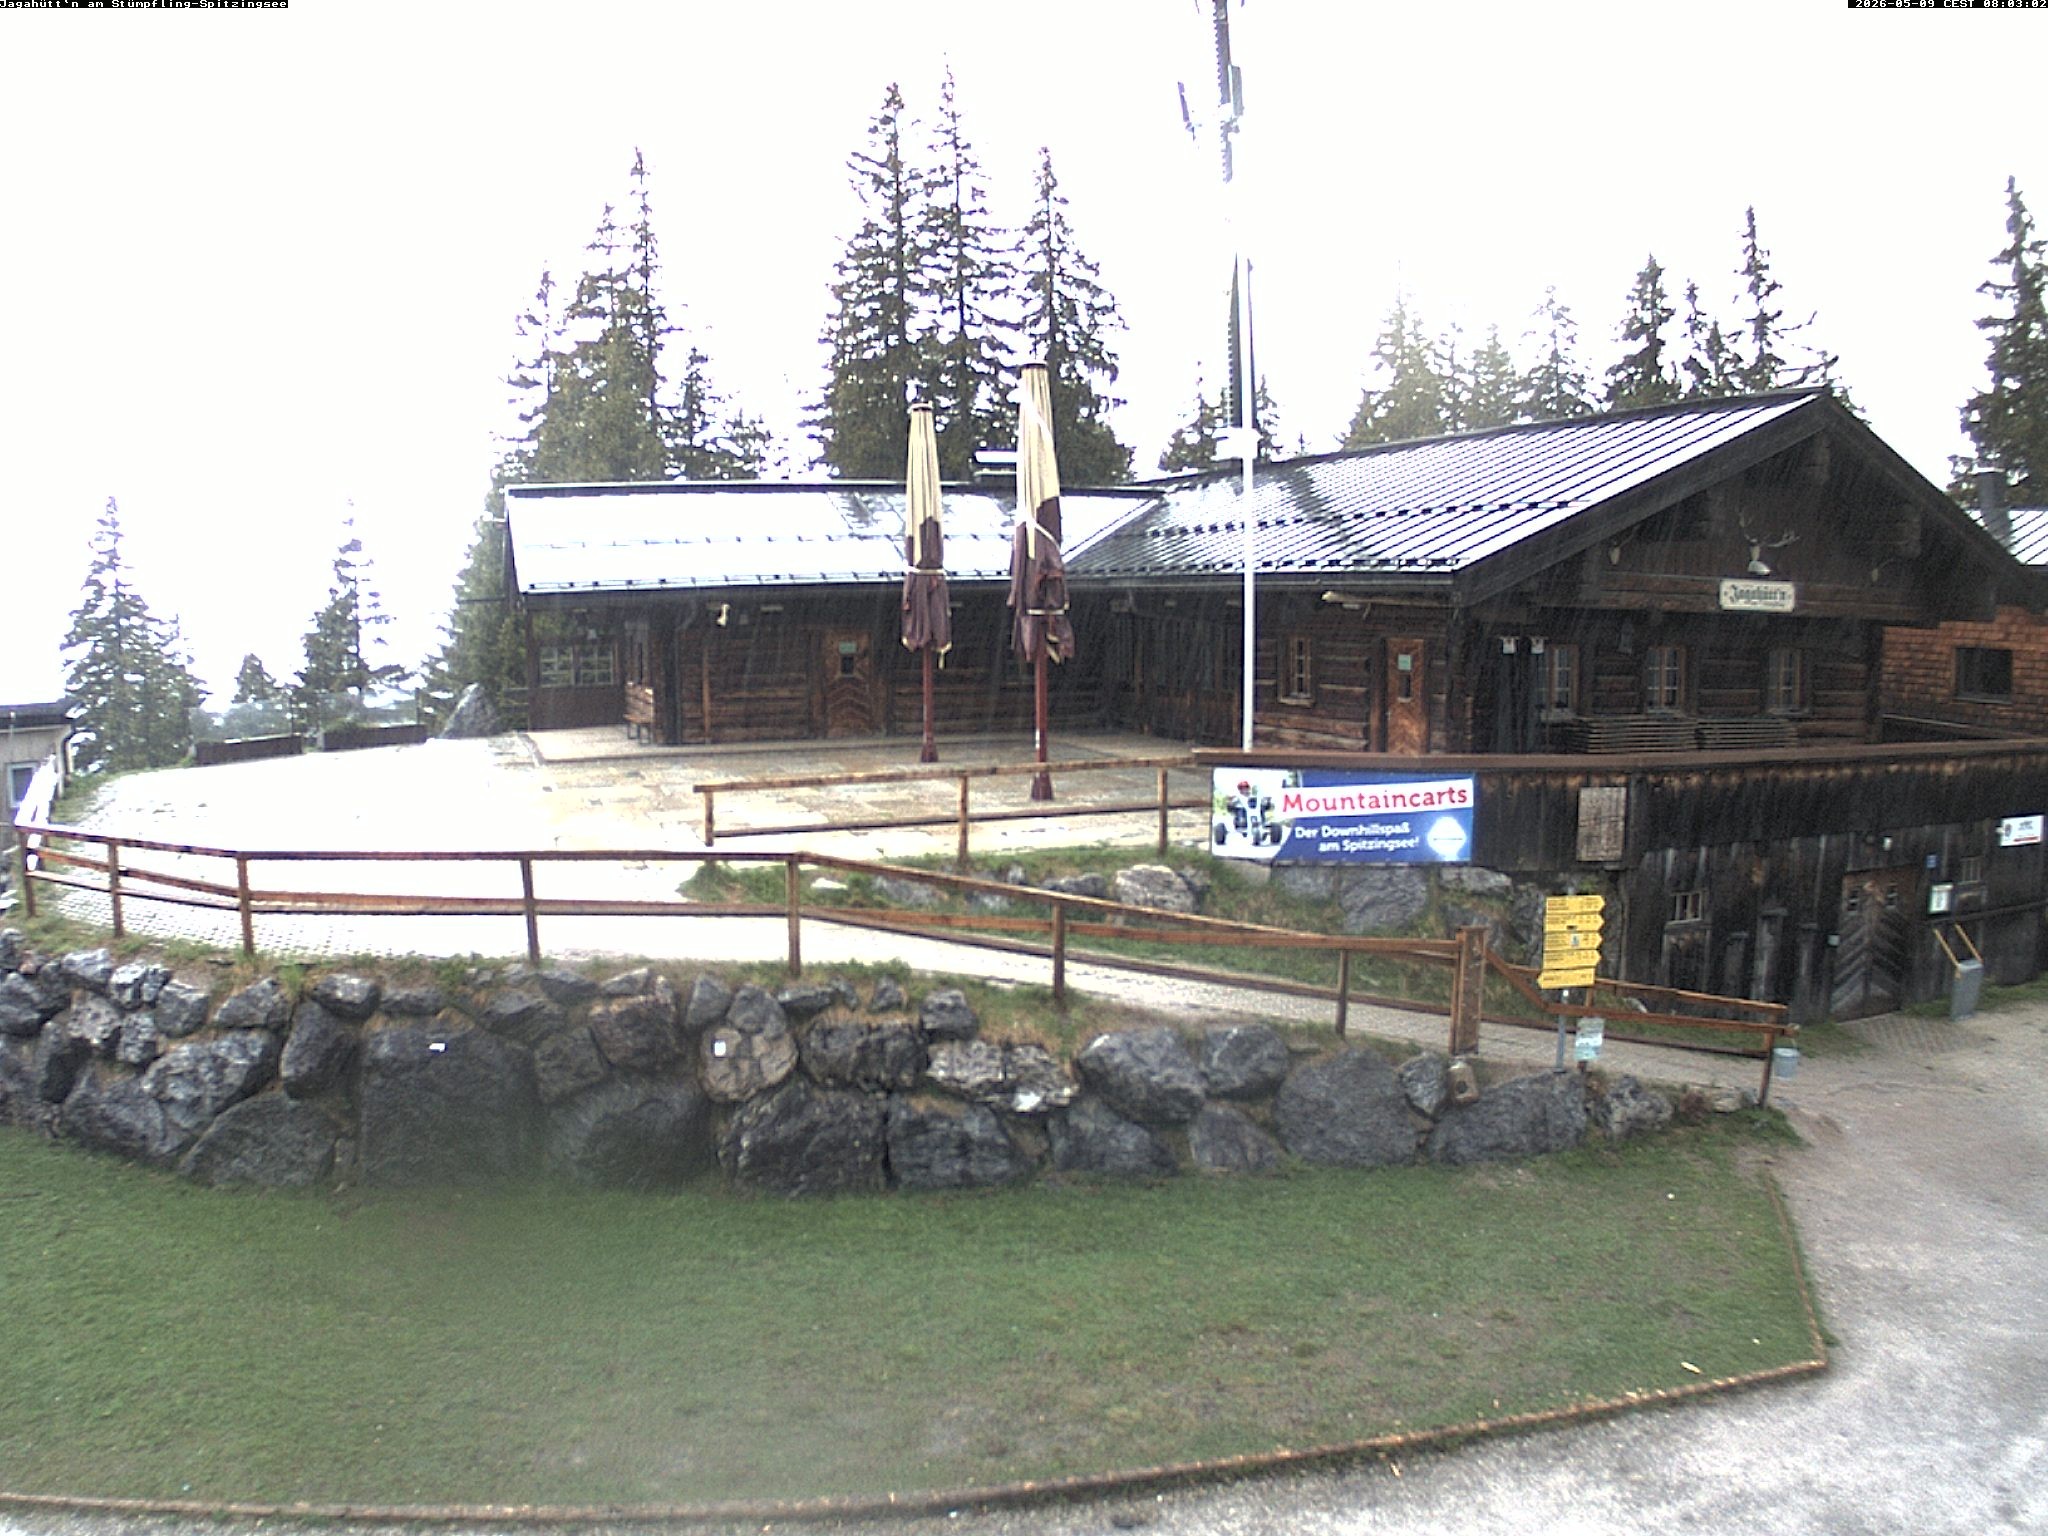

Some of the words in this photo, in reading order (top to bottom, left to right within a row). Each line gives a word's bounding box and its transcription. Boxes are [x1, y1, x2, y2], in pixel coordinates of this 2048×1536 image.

[1282, 787, 1468, 812] Mountaincarts
[1295, 826, 1318, 839] Der
[1319, 841, 1340, 852] am
